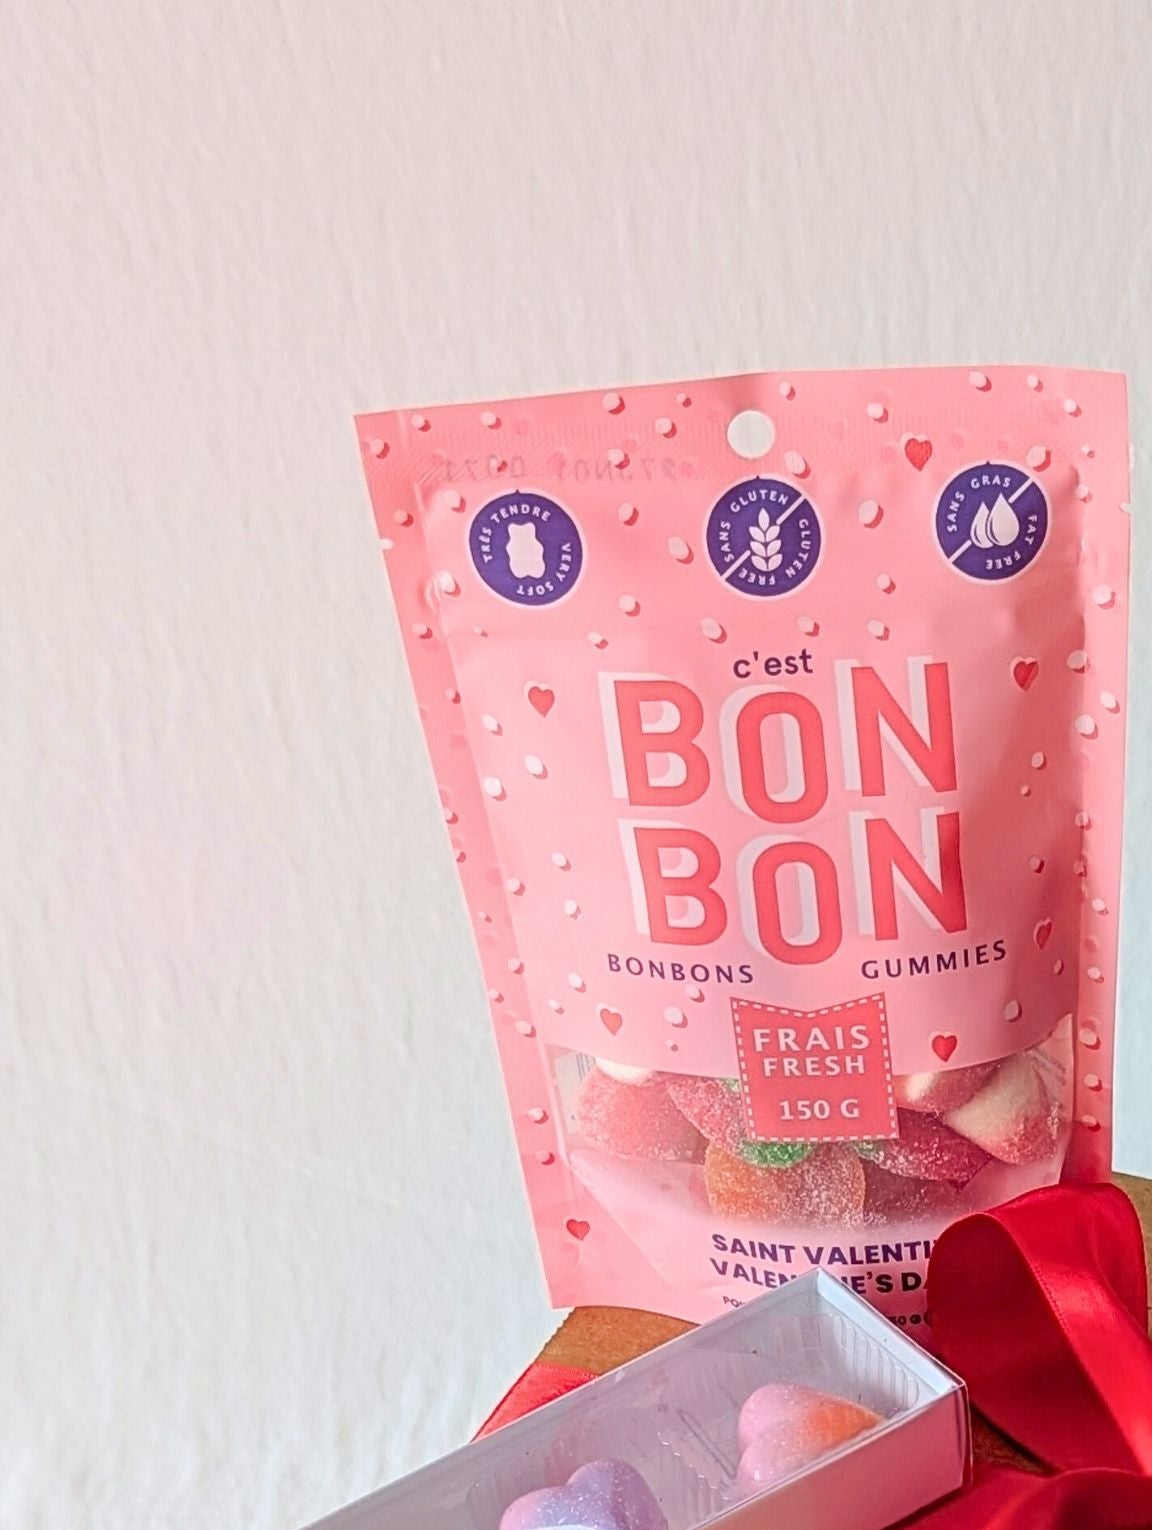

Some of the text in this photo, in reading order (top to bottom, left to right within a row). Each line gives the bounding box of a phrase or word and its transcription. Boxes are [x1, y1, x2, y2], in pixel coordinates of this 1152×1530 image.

[490, 504, 551, 523] TENDRE
[719, 489, 789, 562] SANS GLUTEN
[946, 475, 1011, 532] SANS GRAS
[738, 519, 811, 585] GLUTEN FREE
[985, 514, 1038, 570] FAT FREE
[516, 543, 572, 596] VERY SOFT
[732, 648, 814, 679] c'est
[610, 660, 958, 824] BON
[630, 811, 968, 965] BON
[607, 939, 1007, 984] BONBONS GUMMIES
[752, 1024, 871, 1053] FRAIS
[763, 1054, 866, 1078] FRESH
[779, 1099, 860, 1122] 150 G
[711, 1233, 937, 1265] SAINT VALENTI
